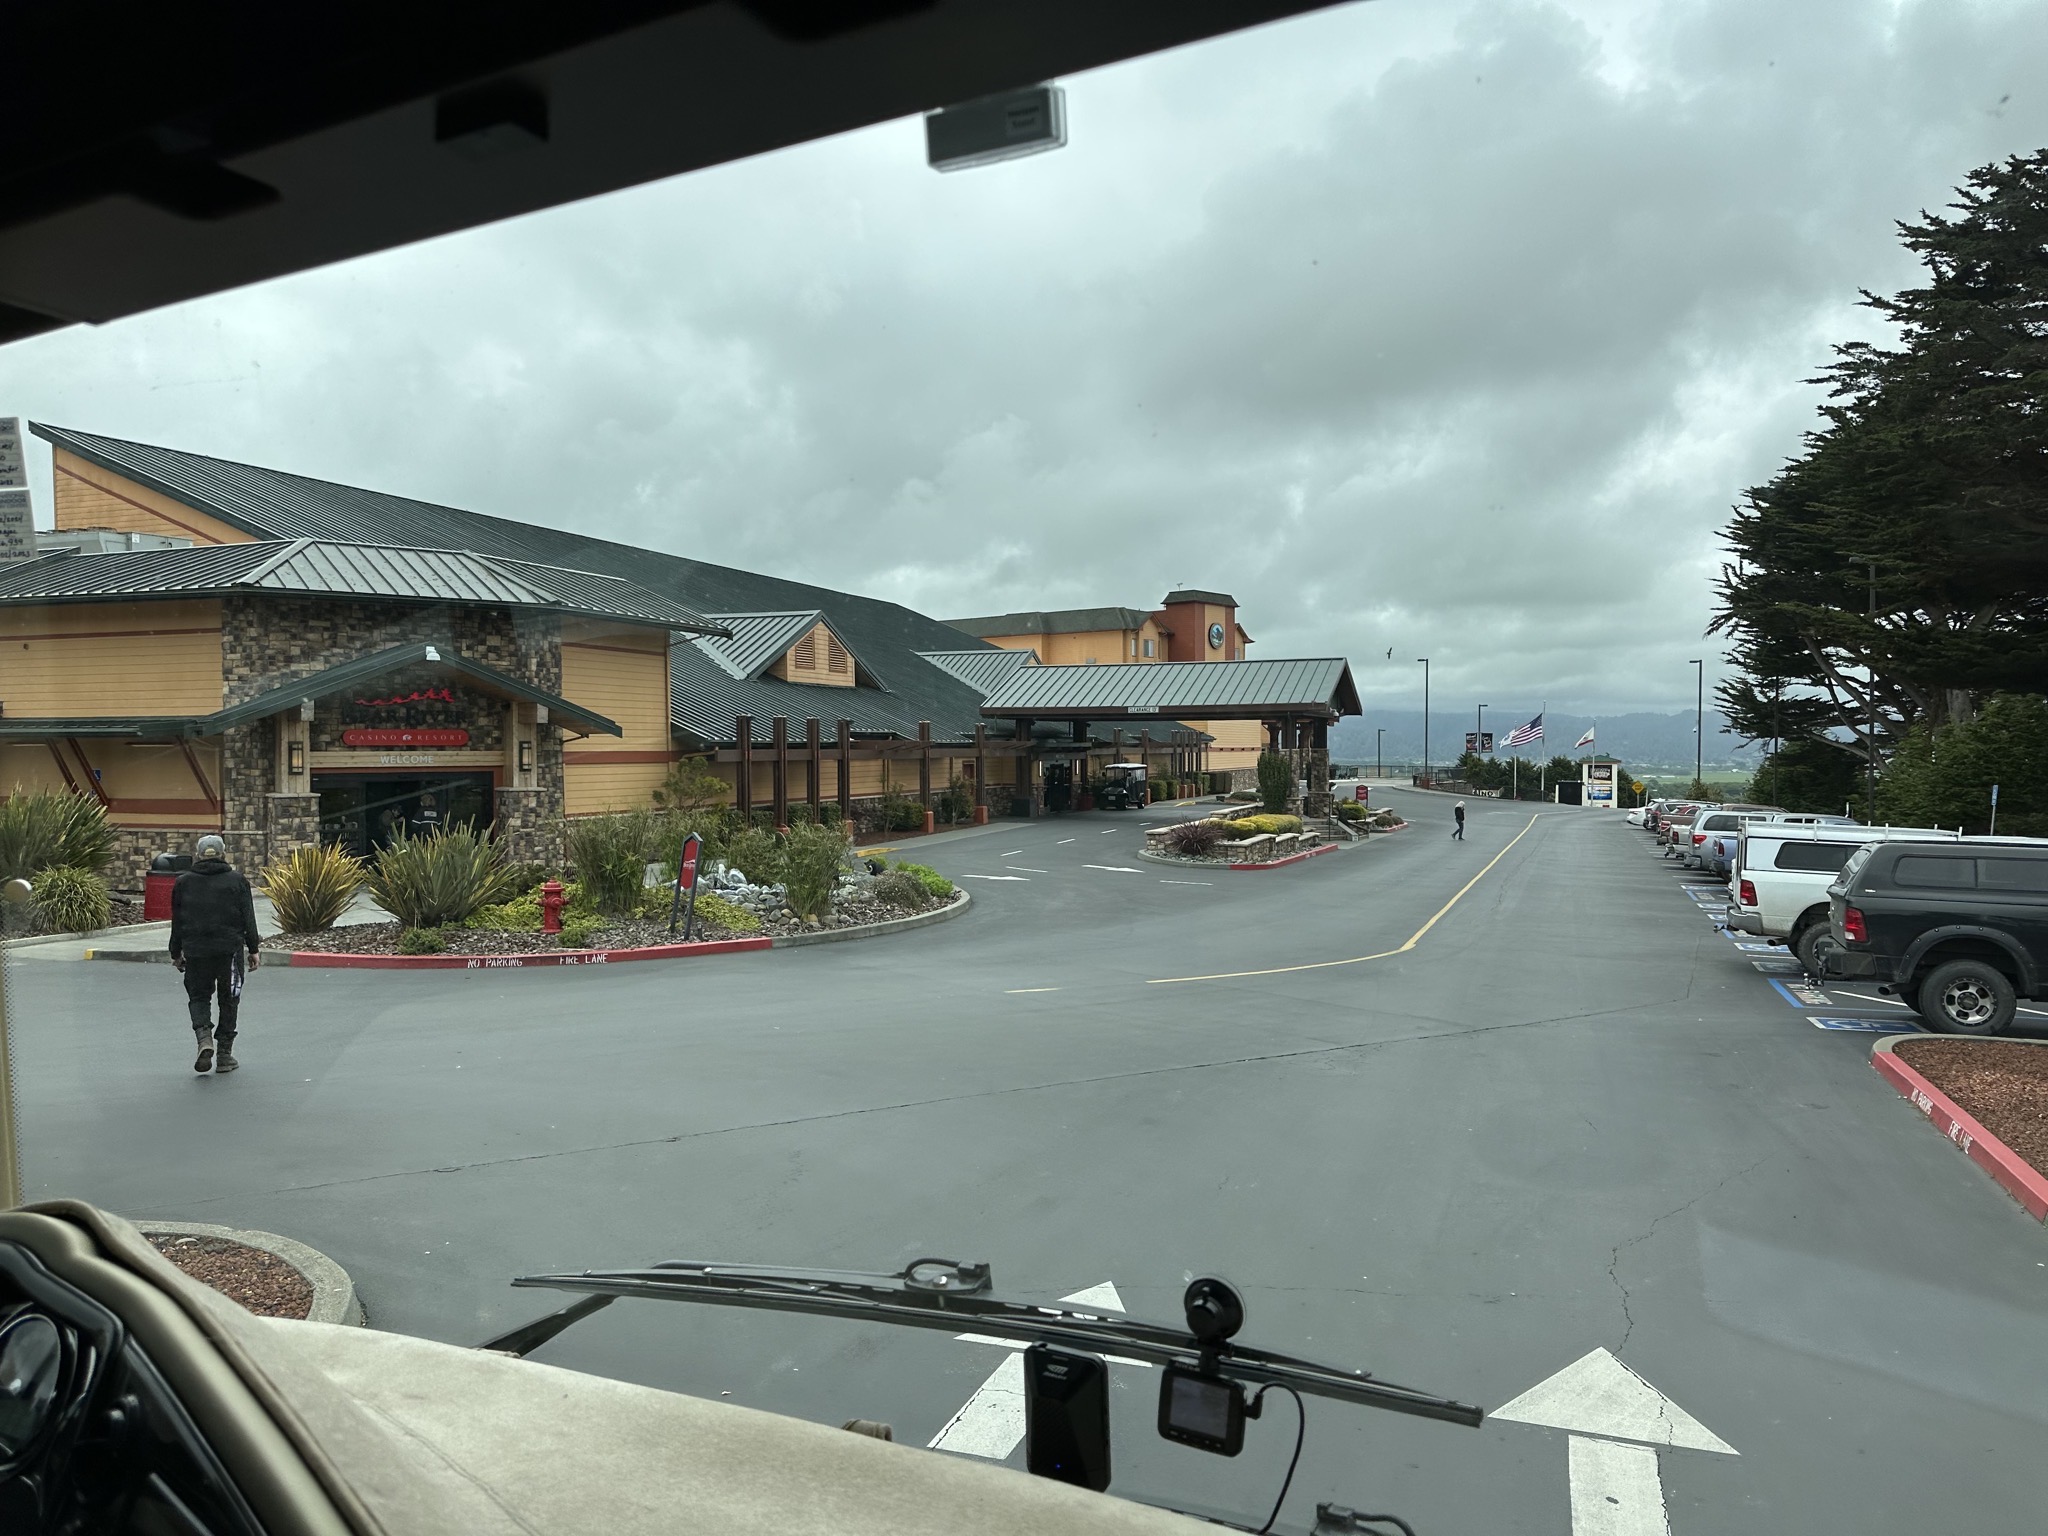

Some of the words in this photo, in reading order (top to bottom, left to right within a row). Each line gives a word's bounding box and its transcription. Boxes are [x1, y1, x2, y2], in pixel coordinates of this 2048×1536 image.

[380, 755, 434, 764] WELCOME
[467, 959, 480, 968] NO
[485, 958, 523, 967] PARKING
[560, 956, 579, 965] FIRE
[585, 954, 608, 964] LANE
[1948, 1120, 1961, 1142] FIRE
